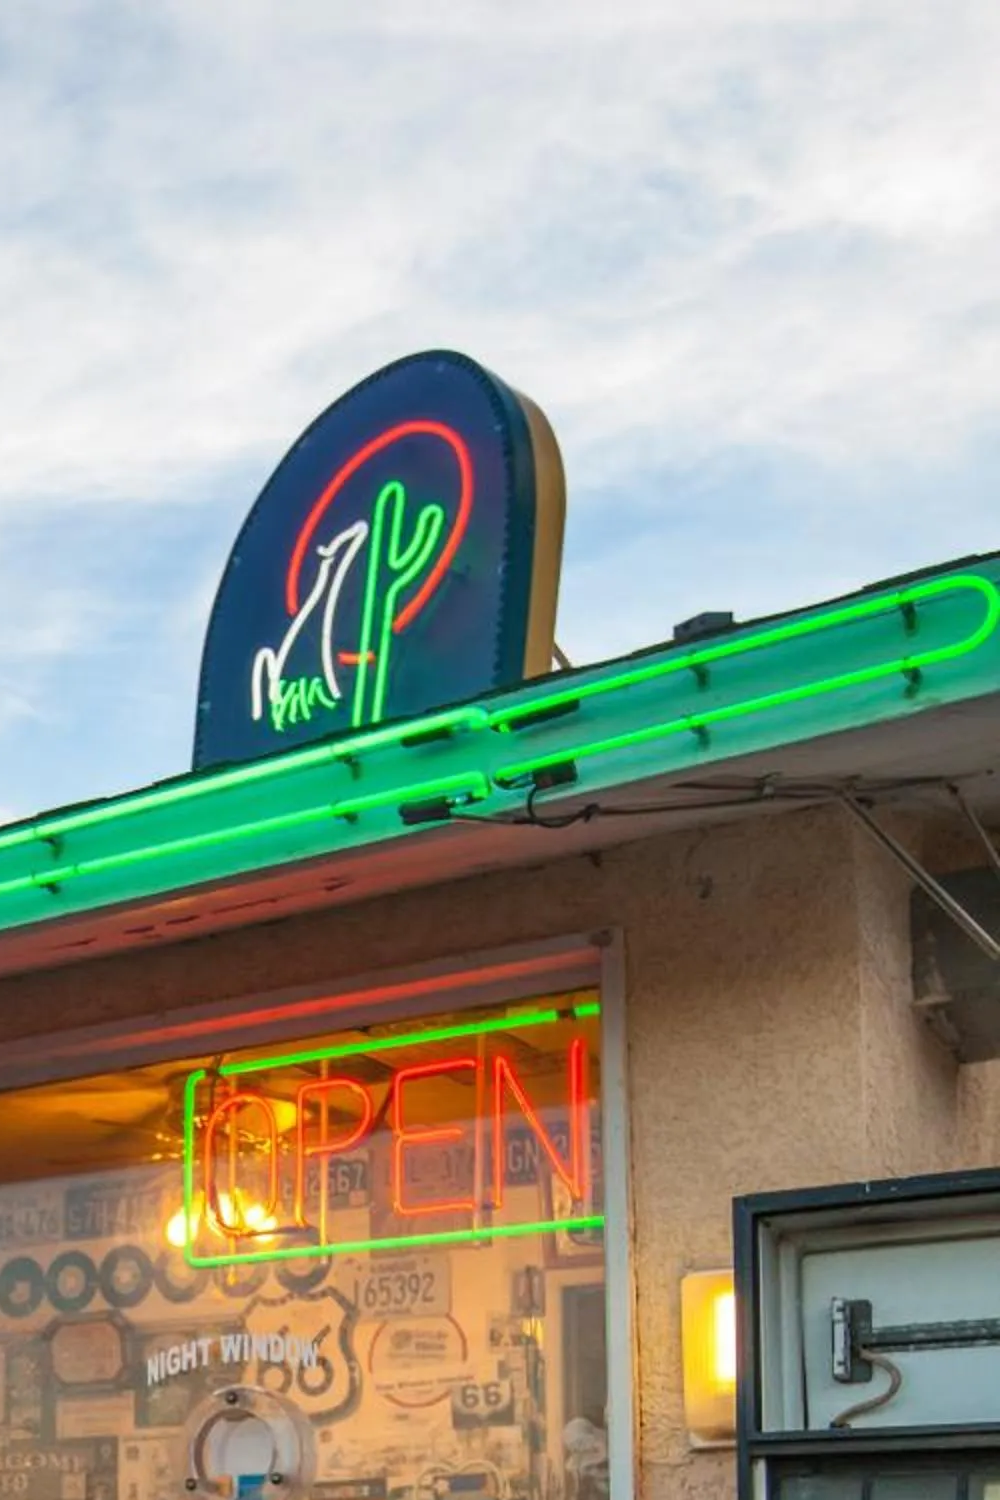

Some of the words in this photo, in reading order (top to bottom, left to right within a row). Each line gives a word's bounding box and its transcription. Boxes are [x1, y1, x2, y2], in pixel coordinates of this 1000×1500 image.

[206, 1037, 588, 1238] OPEN
[147, 1336, 214, 1386] NIGHT
[220, 1333, 320, 1368] WINDOW
[461, 1383, 502, 1408] 66
